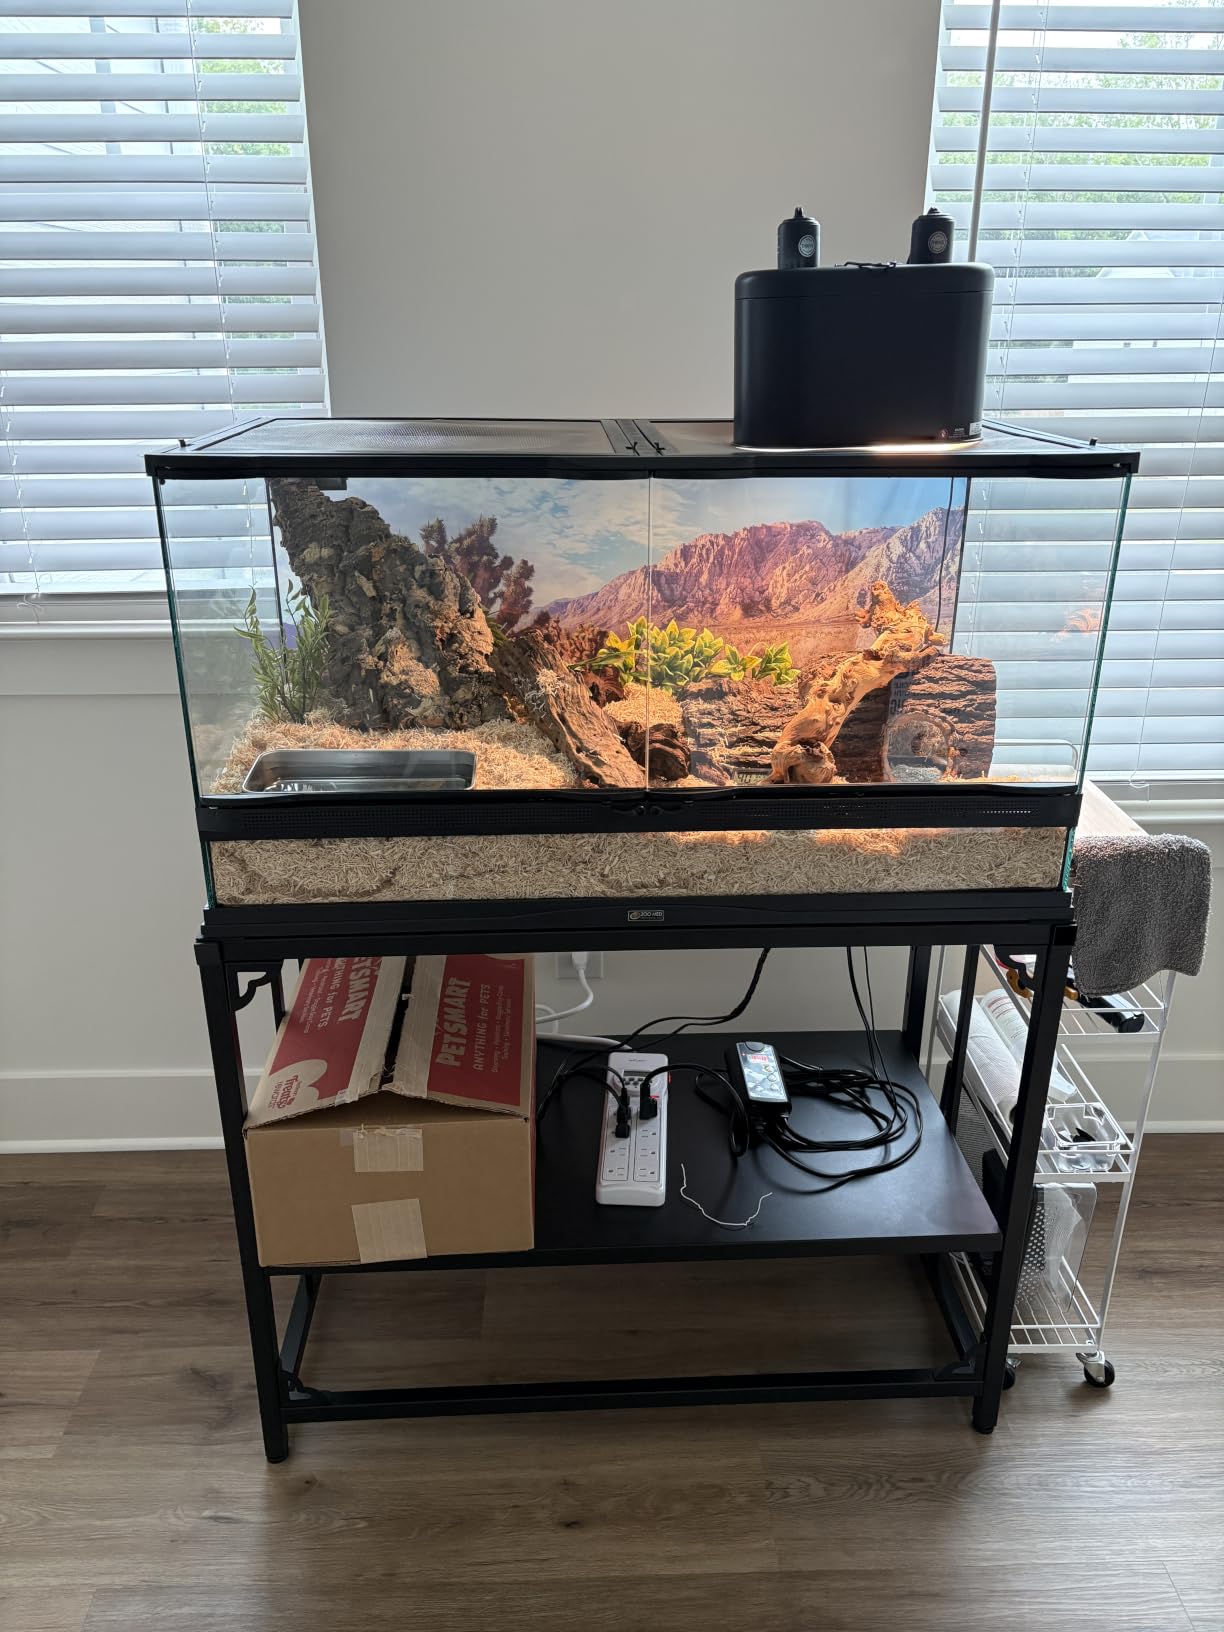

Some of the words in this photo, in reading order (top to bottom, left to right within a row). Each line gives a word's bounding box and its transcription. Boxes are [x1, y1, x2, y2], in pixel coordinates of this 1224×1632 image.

[327, 991, 338, 1004] for
[337, 957, 372, 1022] ETSMART
[480, 983, 491, 1005] PETS
[317, 1006, 333, 1029] PETS
[436, 979, 471, 1067] PETSMART
[479, 1007, 489, 1021] for
[472, 1022, 488, 1071] ANYTHING
[277, 1075, 299, 1110] Treats
